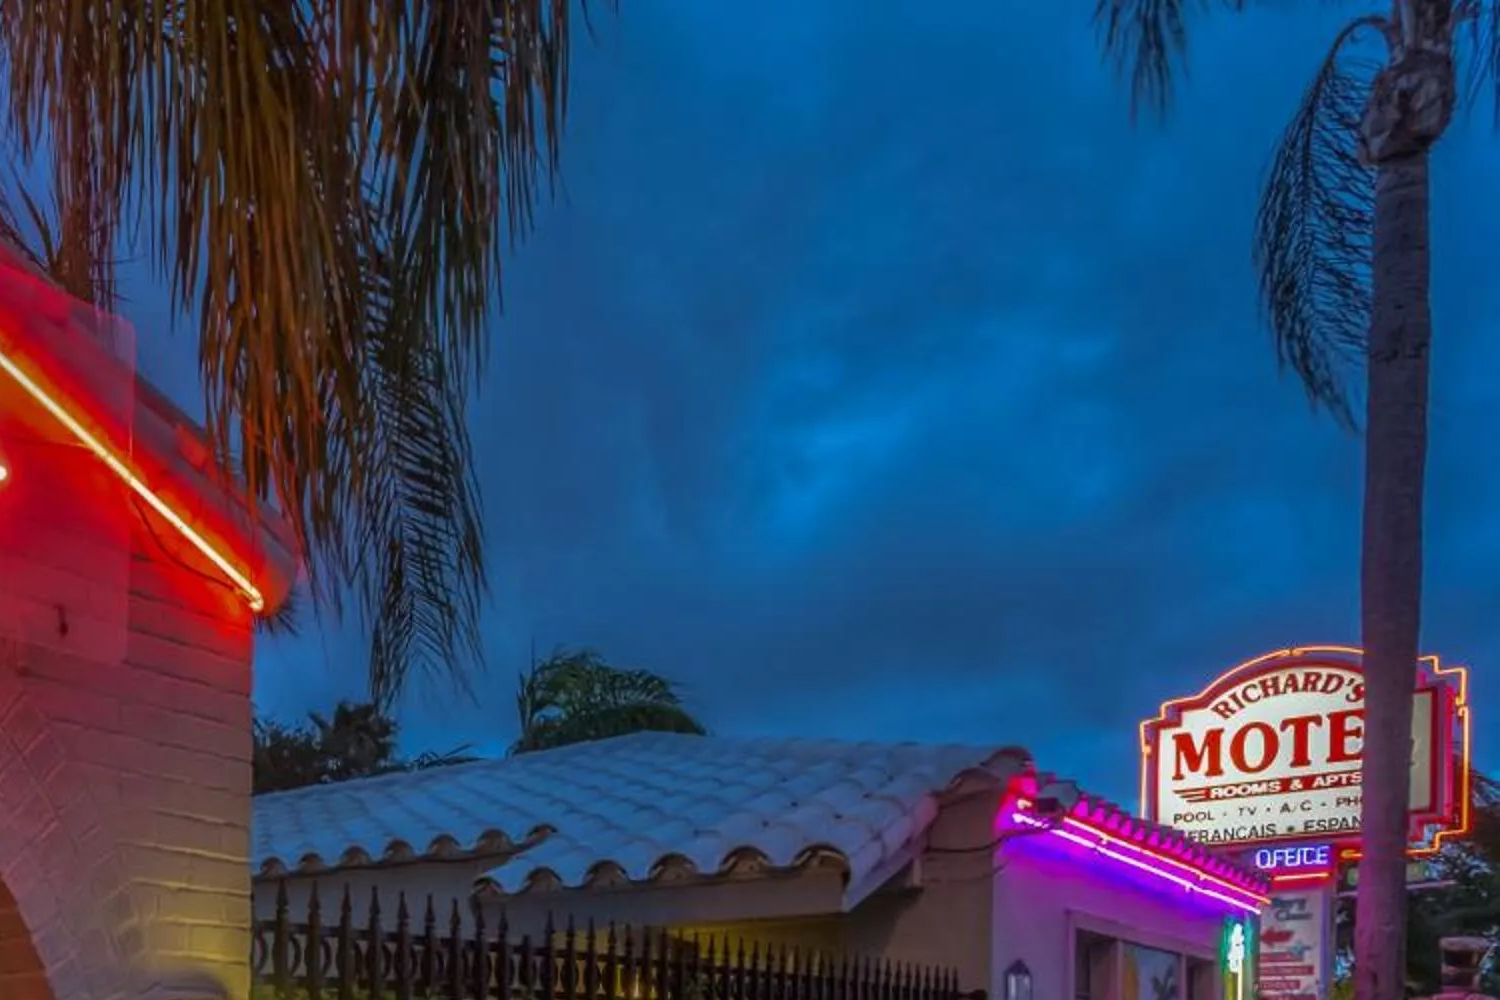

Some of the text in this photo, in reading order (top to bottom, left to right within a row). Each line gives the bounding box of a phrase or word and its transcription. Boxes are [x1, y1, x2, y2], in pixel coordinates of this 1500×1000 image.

[1211, 670, 1365, 721] RICHARD'S
[1171, 708, 1364, 781] MOTE
[1210, 771, 1363, 800] ROOMS & APTS
[1173, 811, 1215, 825] POOL
[1237, 806, 1257, 817] TV
[1279, 800, 1312, 814] A/C
[1303, 816, 1363, 833] ESPAN
[1255, 845, 1330, 870] OFFICE
